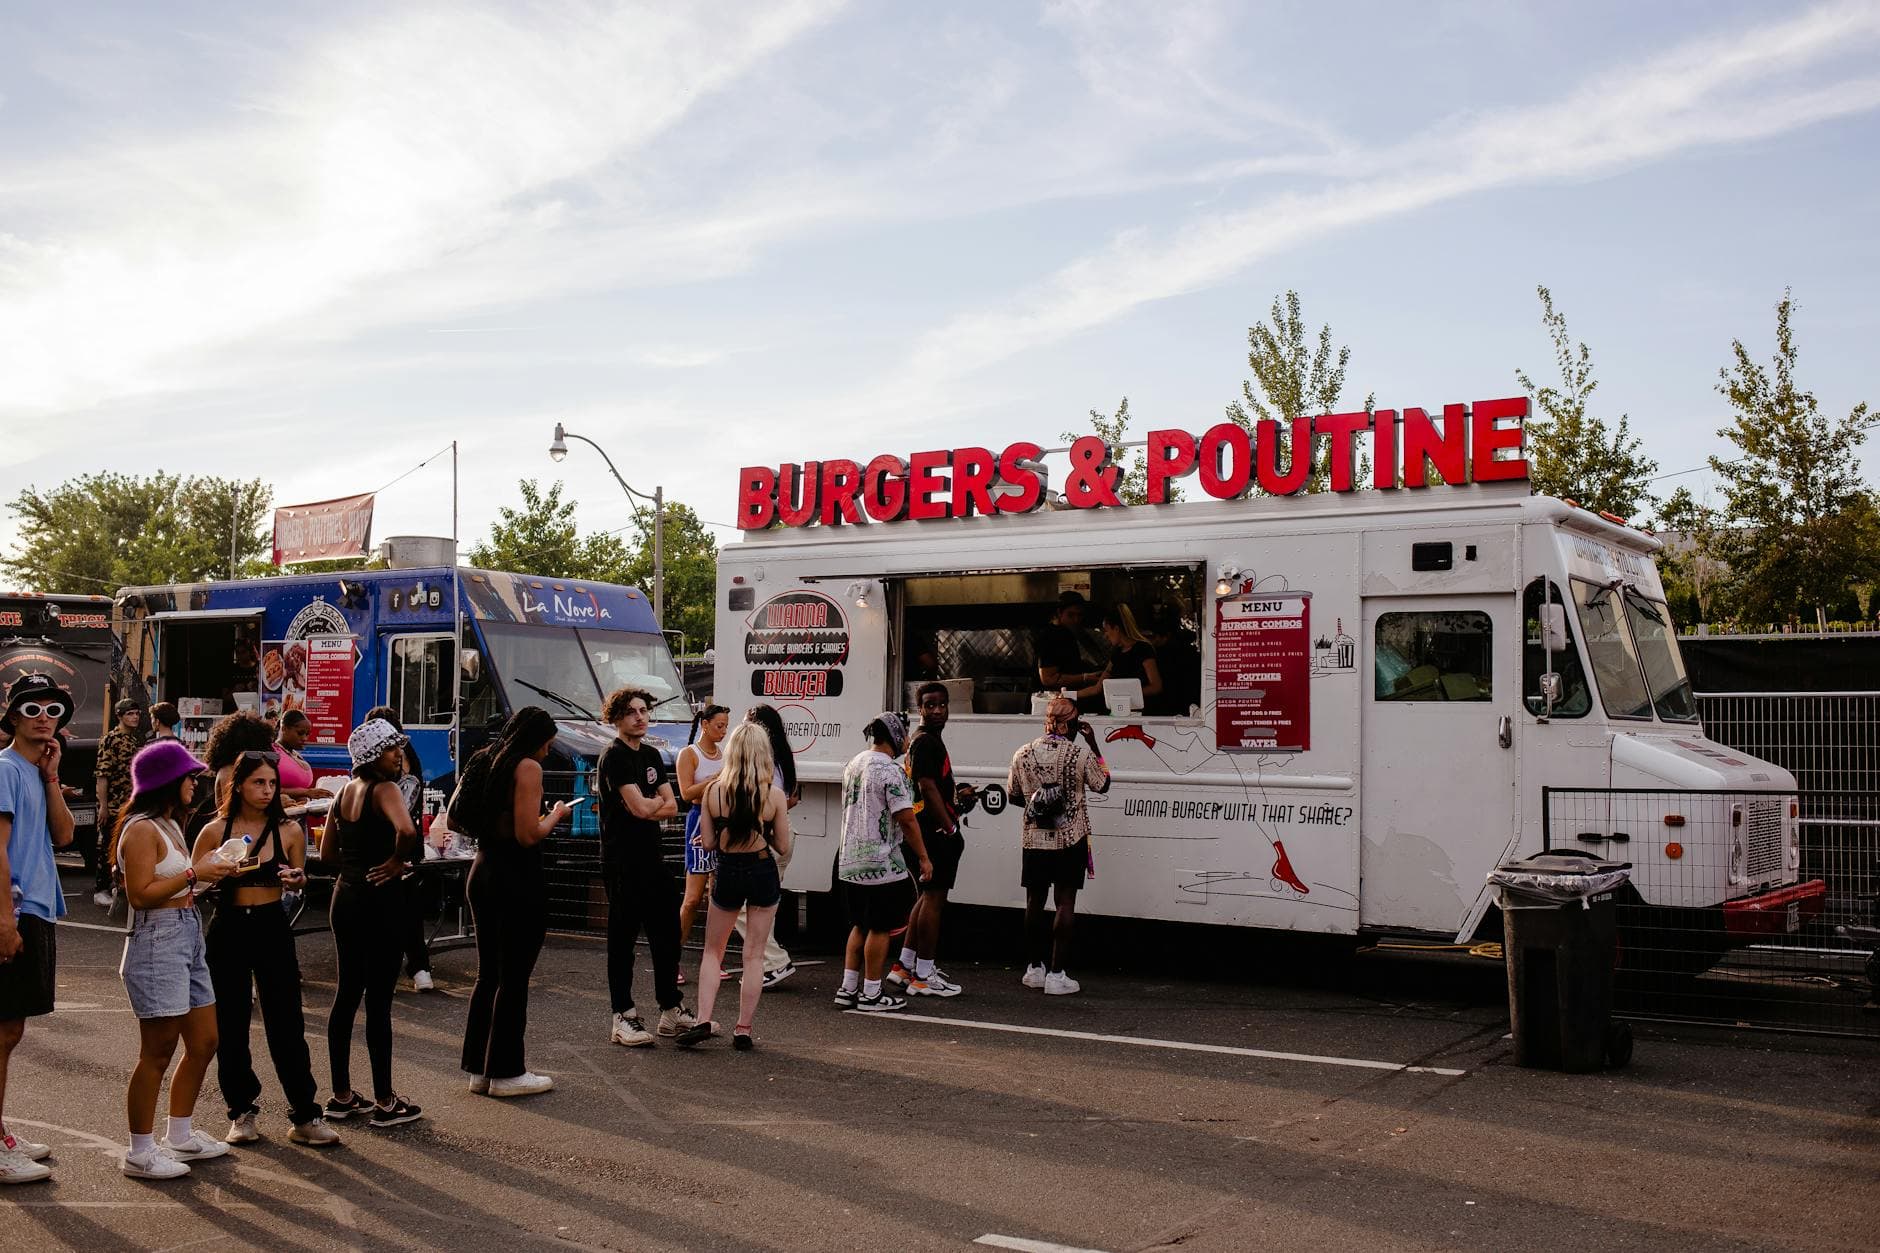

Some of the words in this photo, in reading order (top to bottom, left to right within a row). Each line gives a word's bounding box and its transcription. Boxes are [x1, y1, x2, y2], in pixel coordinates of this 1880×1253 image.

[737, 442, 1046, 530] BURGERS
[1066, 434, 1125, 509] &
[1146, 396, 1532, 505] POUTINE
[522, 591, 549, 612] La
[554, 591, 612, 623] Novela
[1241, 601, 1283, 613] MENU
[58, 614, 109, 629] TRUCK
[767, 602, 828, 628] WANNA
[1221, 621, 1259, 630] BURGER
[1261, 619, 1303, 629] COMBOS
[321, 640, 342, 648] MENU
[748, 643, 768, 655] FRESH
[768, 643, 786, 654] MADE
[787, 643, 814, 654] BURGERS
[1237, 673, 1282, 681] POUTINES
[763, 670, 828, 699] BURGER
[1240, 739, 1278, 748] WATER
[1124, 799, 1168, 817] WANNA
[1172, 801, 1219, 820] BURGER
[1223, 803, 1257, 822] WITH
[1262, 804, 1294, 823] THAT
